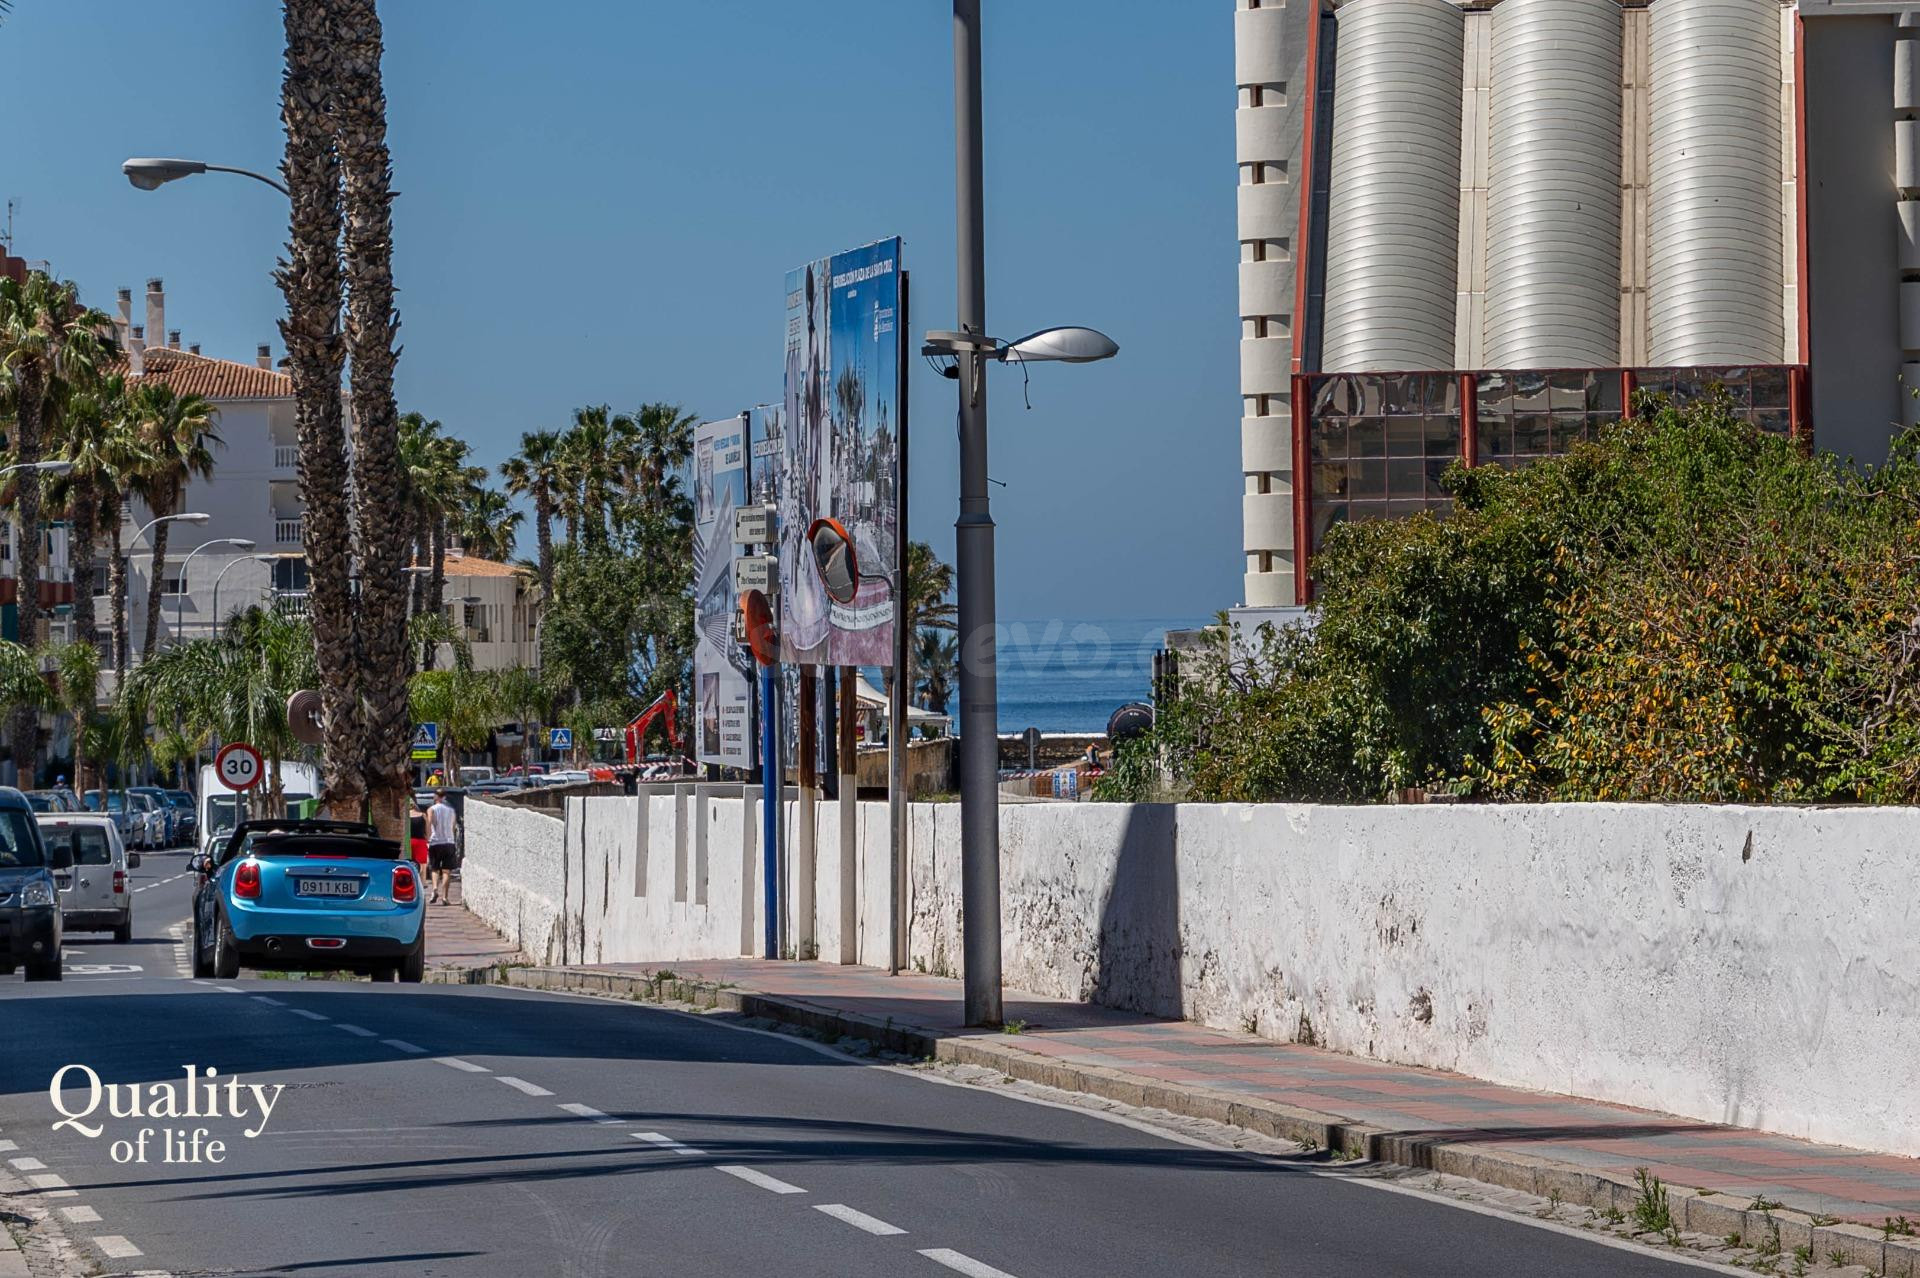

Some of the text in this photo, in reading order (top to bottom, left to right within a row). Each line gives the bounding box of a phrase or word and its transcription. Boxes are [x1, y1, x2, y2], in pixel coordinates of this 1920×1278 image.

[227, 759, 252, 774] 30
[302, 881, 356, 894] 0911 KBL
